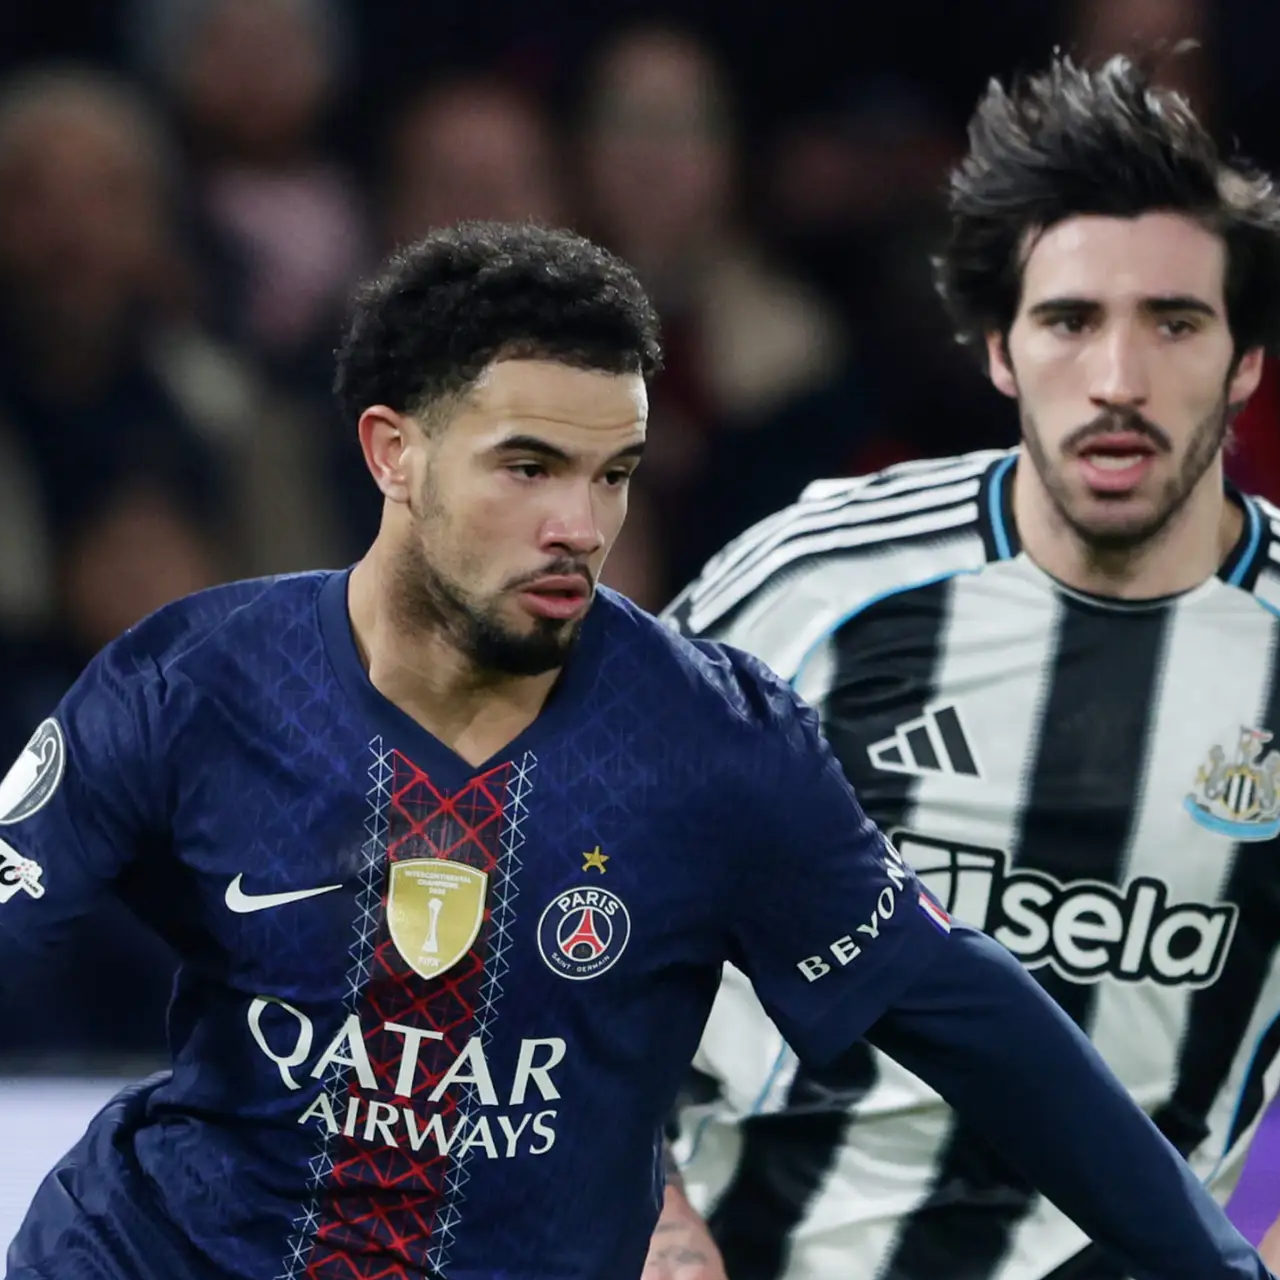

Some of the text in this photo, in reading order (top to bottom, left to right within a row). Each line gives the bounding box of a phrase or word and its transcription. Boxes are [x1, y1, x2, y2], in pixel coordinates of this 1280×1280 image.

[557, 890, 619, 916] PARIS
[993, 882, 1232, 981] sela
[247, 997, 567, 1106] QATAR
[297, 1092, 557, 1159] AIRWAYS
